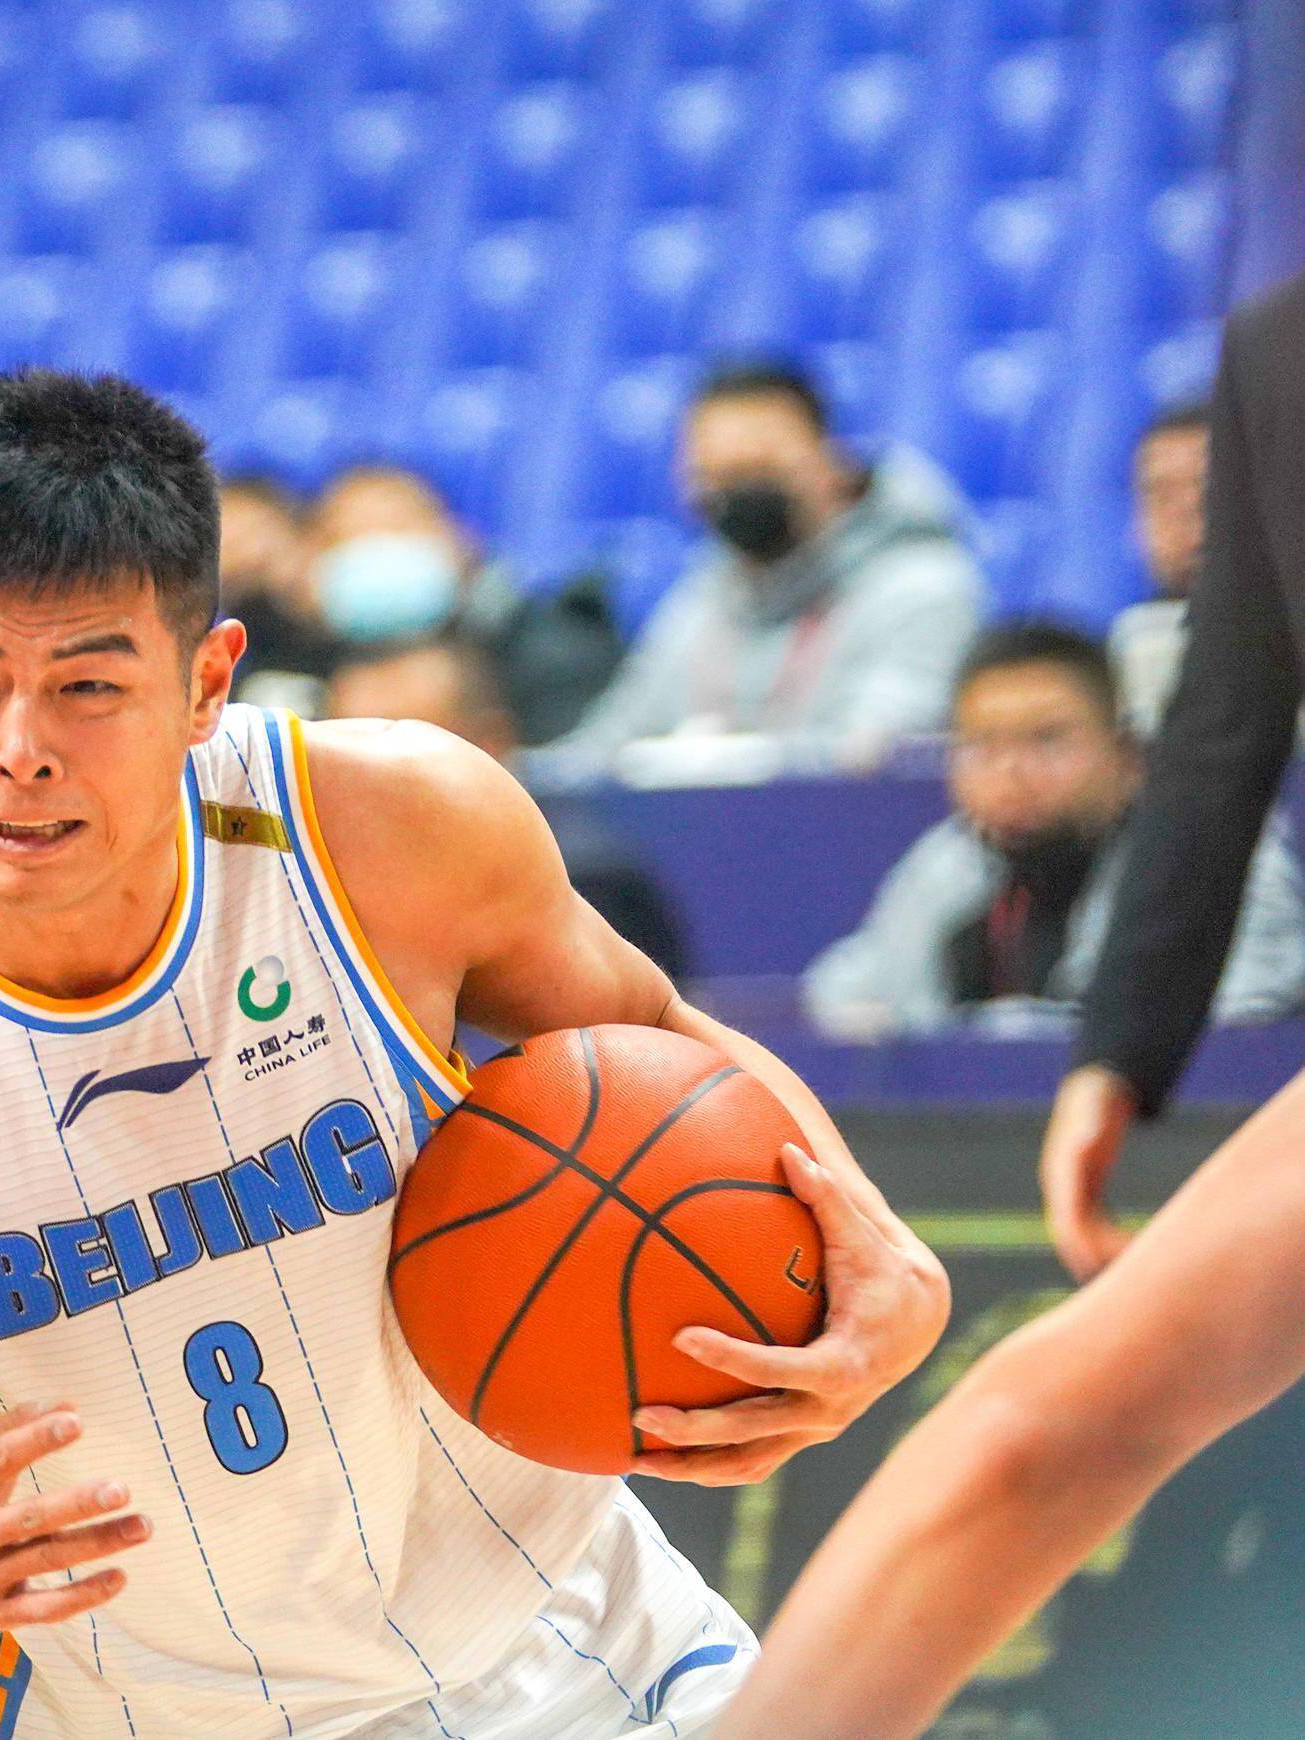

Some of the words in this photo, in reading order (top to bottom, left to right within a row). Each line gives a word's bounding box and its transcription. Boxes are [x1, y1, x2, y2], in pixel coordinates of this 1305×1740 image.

[236, 1013, 326, 1066] 中国人寿
[244, 1054, 296, 1081] CHINA
[299, 1033, 332, 1057] LIFE
[183, 1320, 289, 1475] 8
